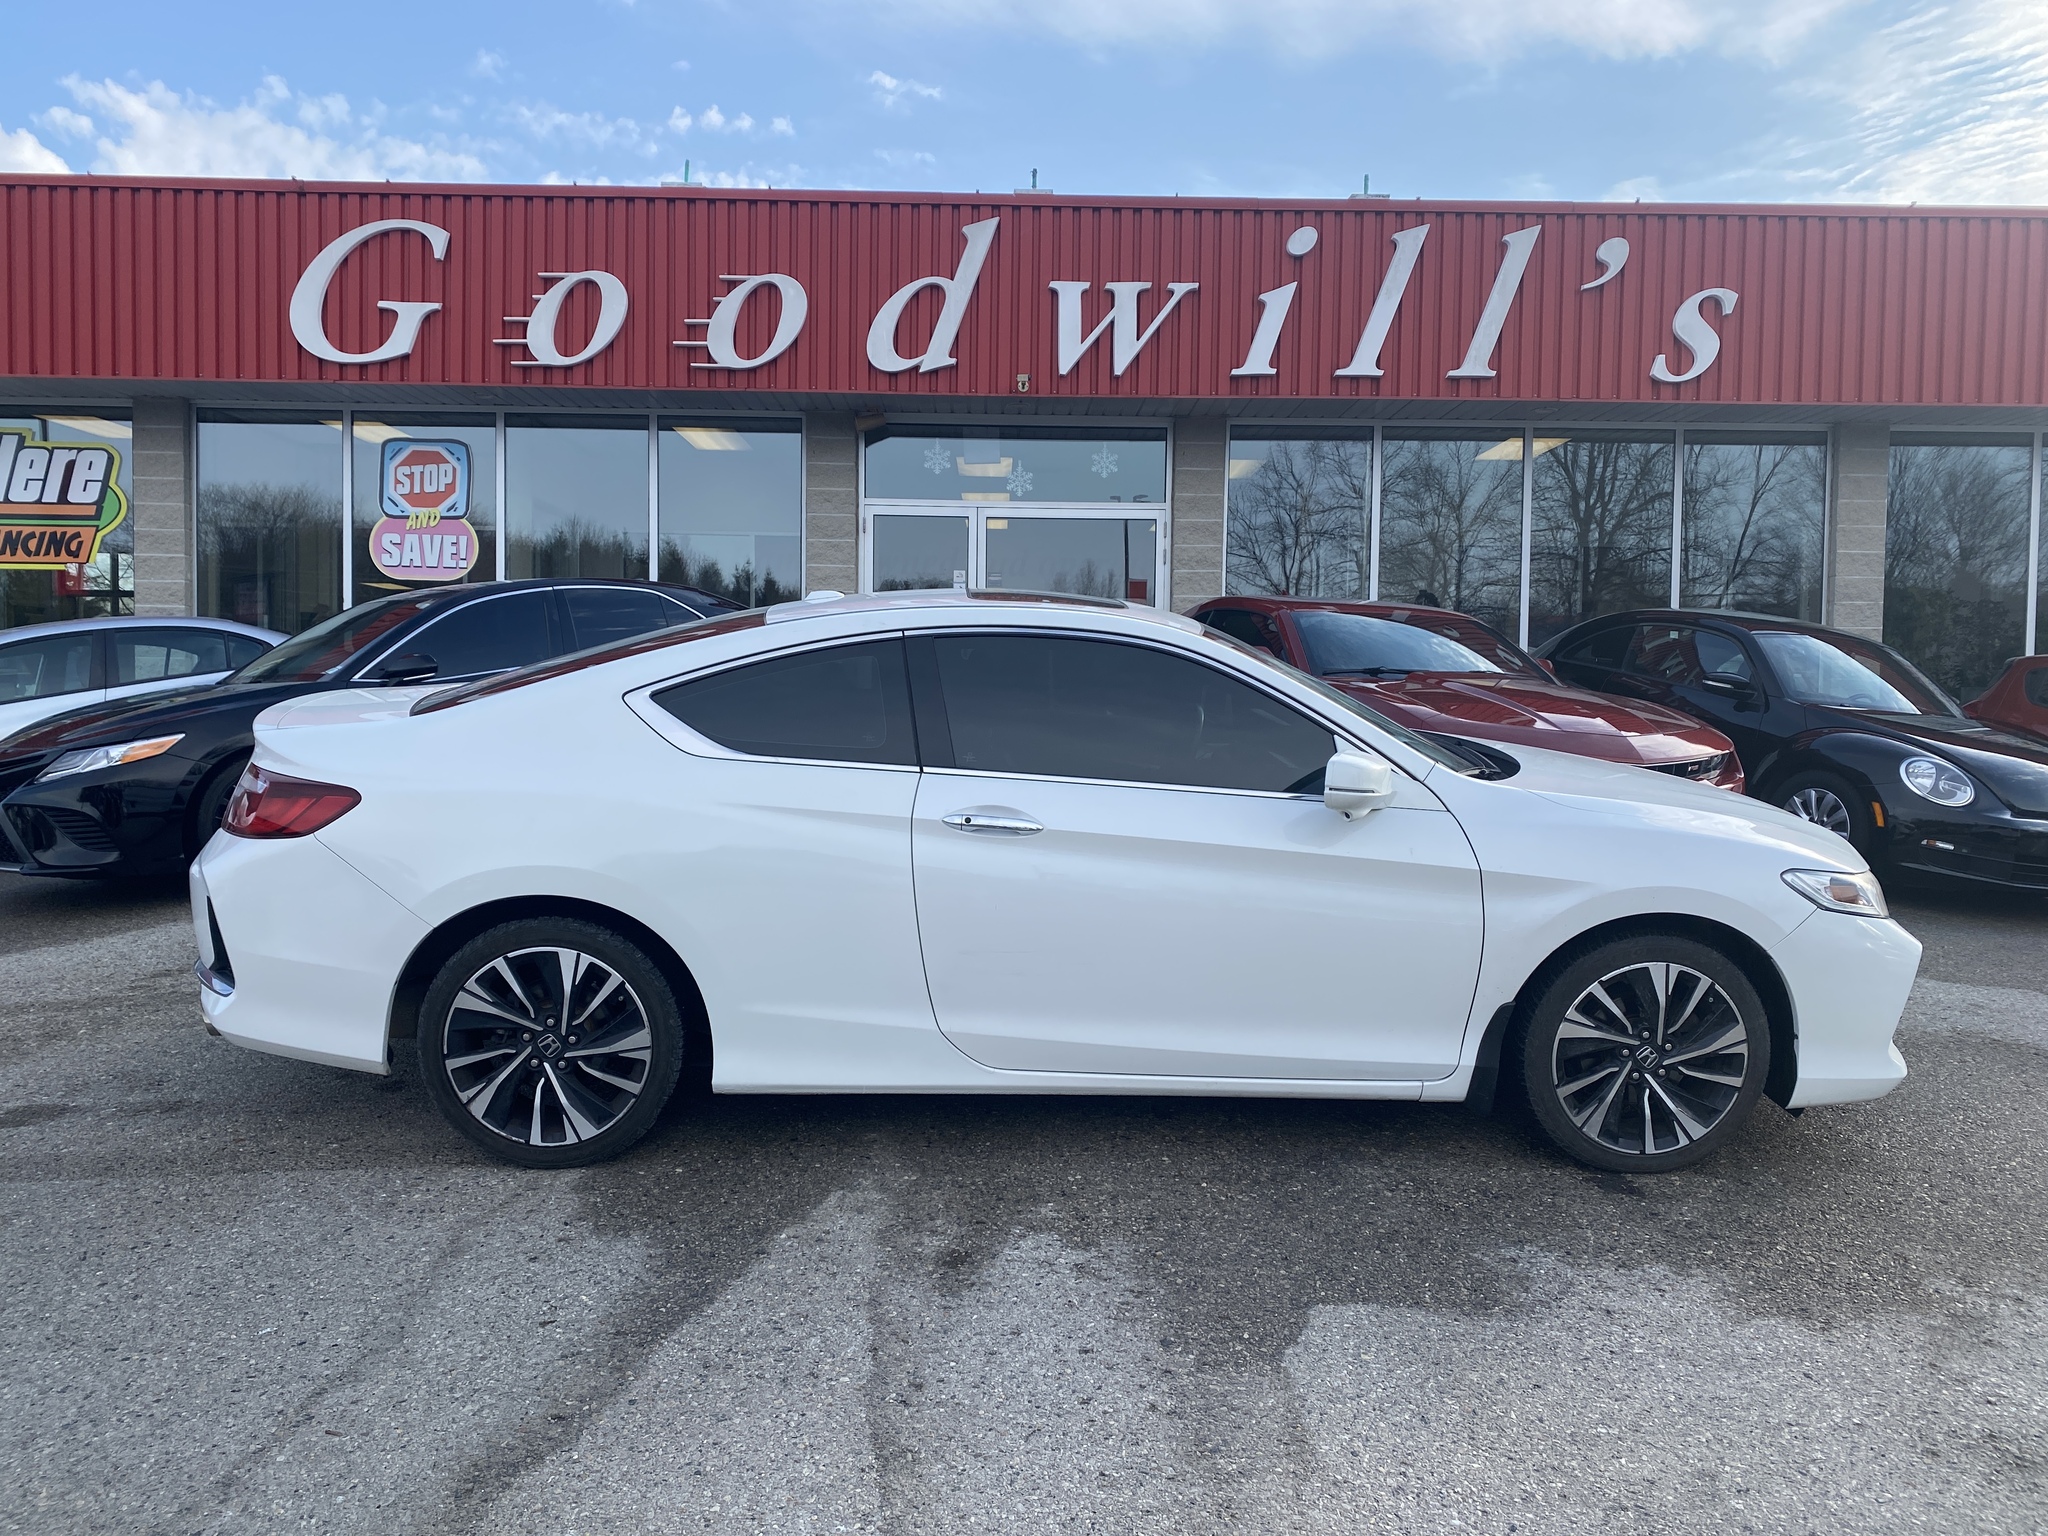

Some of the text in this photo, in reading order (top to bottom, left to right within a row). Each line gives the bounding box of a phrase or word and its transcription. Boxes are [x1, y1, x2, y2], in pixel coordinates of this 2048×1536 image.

[289, 214, 1739, 384] Goodwill's
[395, 463, 454, 495] STOP
[406, 508, 441, 530] AND
[0, 529, 84, 558] NCING
[381, 532, 468, 569] SAVE!
